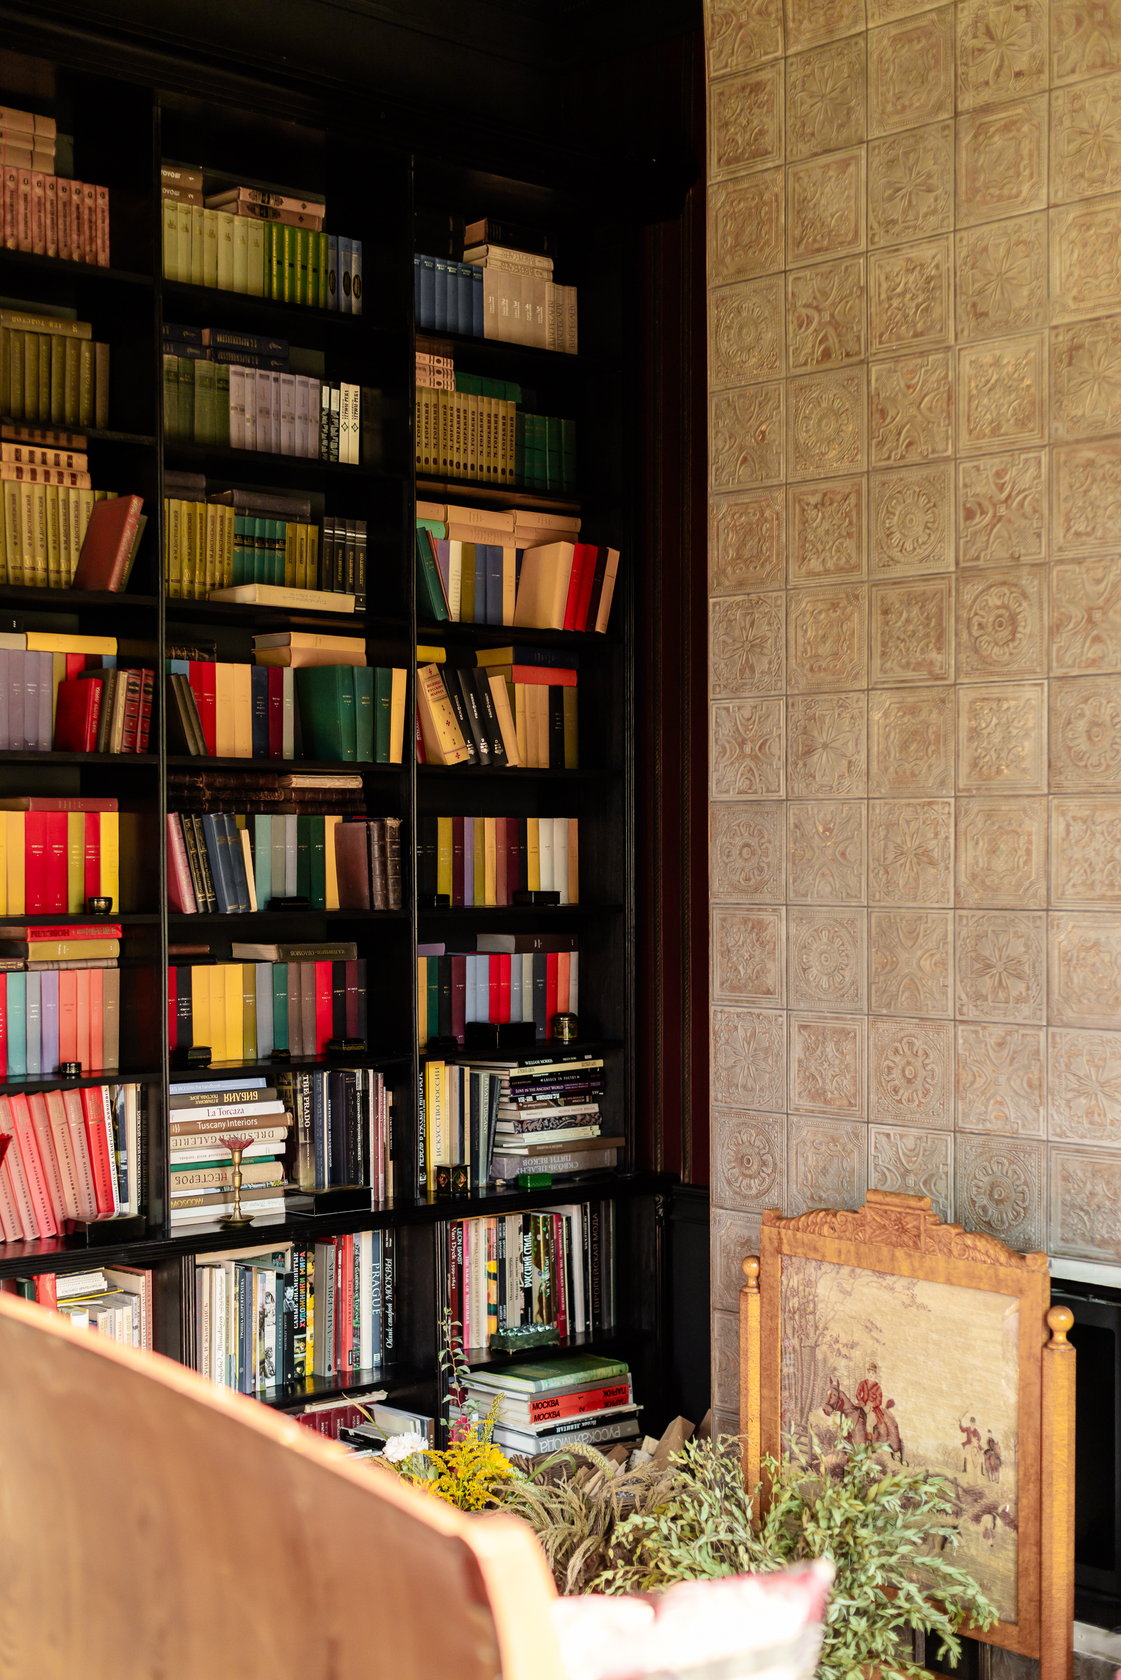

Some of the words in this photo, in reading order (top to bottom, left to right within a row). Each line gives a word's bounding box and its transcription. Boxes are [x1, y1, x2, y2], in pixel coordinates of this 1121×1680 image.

[223, 1090, 258, 1103] БИБЛИЯ
[206, 1108, 216, 1117] La
[196, 1121, 226, 1130] Tuscany
[227, 1119, 258, 1128] Interiors
[172, 1136, 217, 1147] GALERIE
[522, 1157, 548, 1165] ВЕКОВ
[550, 1155, 571, 1164] ПЯТИ
[515, 1164, 547, 1174] ПЕЛЕНУ
[548, 1162, 579, 1171] СКВОЗЬ
[523, 1232, 532, 1255] СТИЛЬ
[522, 1256, 533, 1288] РУССКИЙ
[372, 1263, 380, 1315] PRAGUE
[385, 1303, 394, 1326] старой
[604, 1386, 627, 1398] ПАРИЖ
[532, 1399, 560, 1411] МОСКВА
[604, 1398, 627, 1408] ПАРИЖ
[534, 1410, 560, 1422] МОСКВА
[556, 1423, 580, 1433] ЛЕВИТАН
